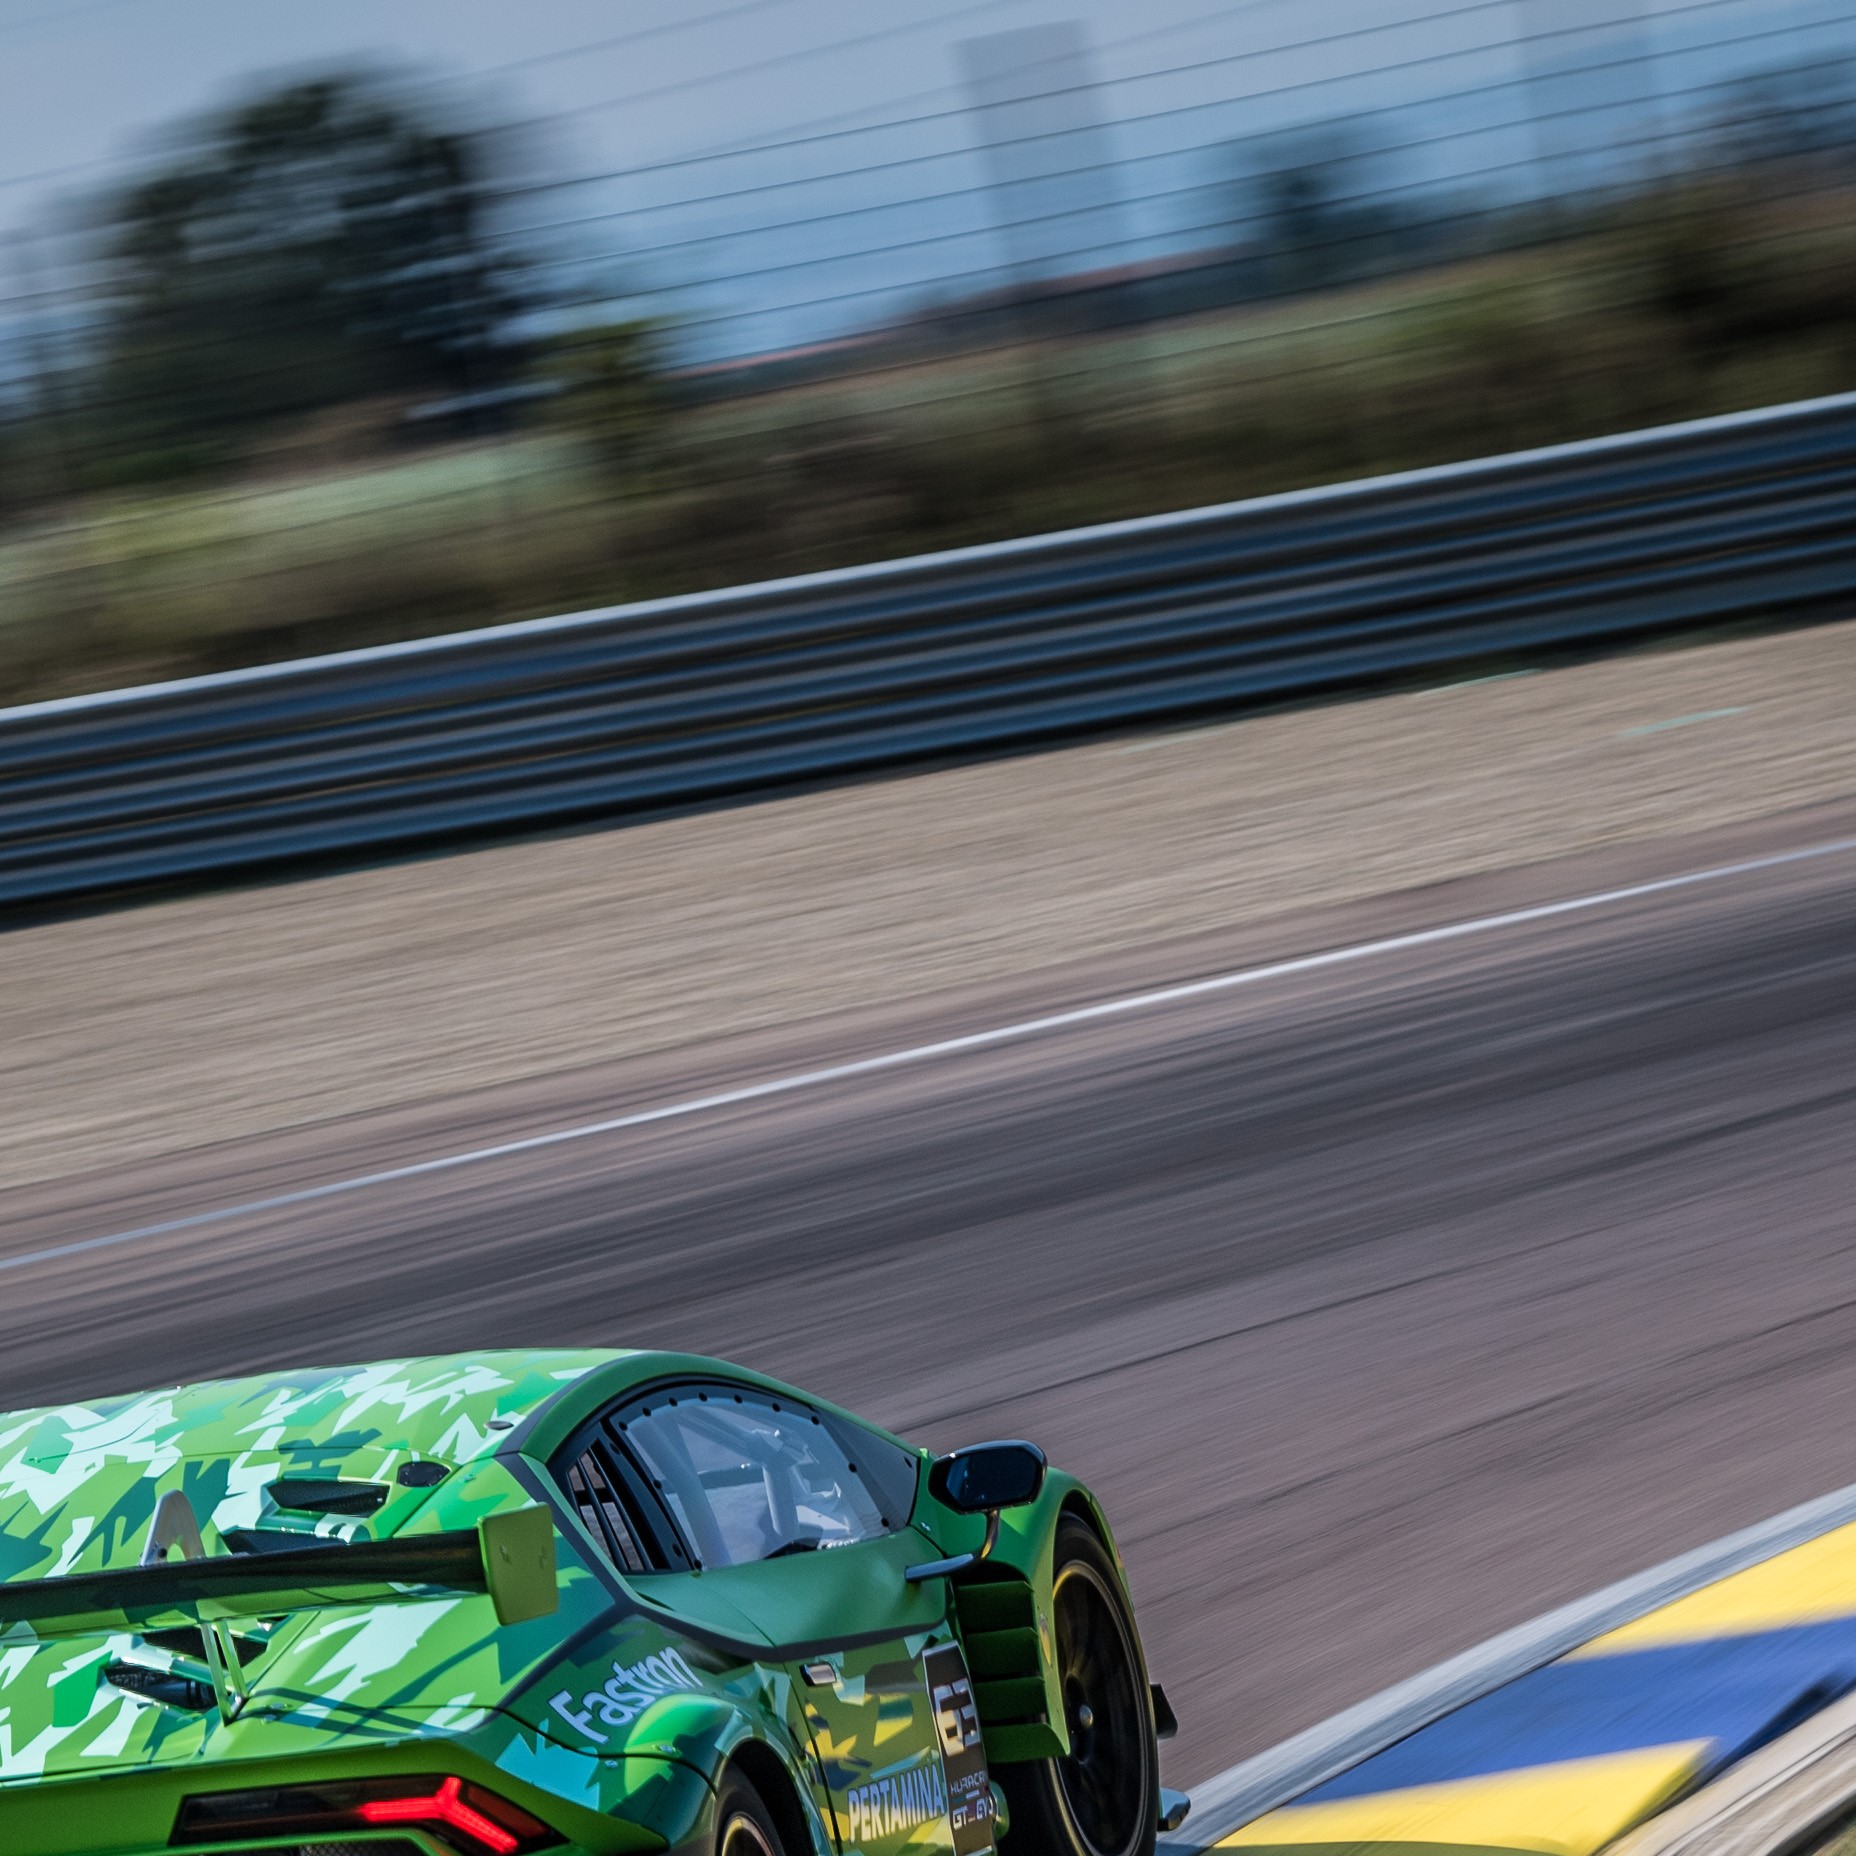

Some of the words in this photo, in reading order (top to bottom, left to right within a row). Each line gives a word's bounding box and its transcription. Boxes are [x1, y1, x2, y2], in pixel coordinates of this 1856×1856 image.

[548, 1646, 704, 1745] Fastron
[932, 1677, 981, 1757] 63
[847, 1763, 945, 1845] PERTAMINA
